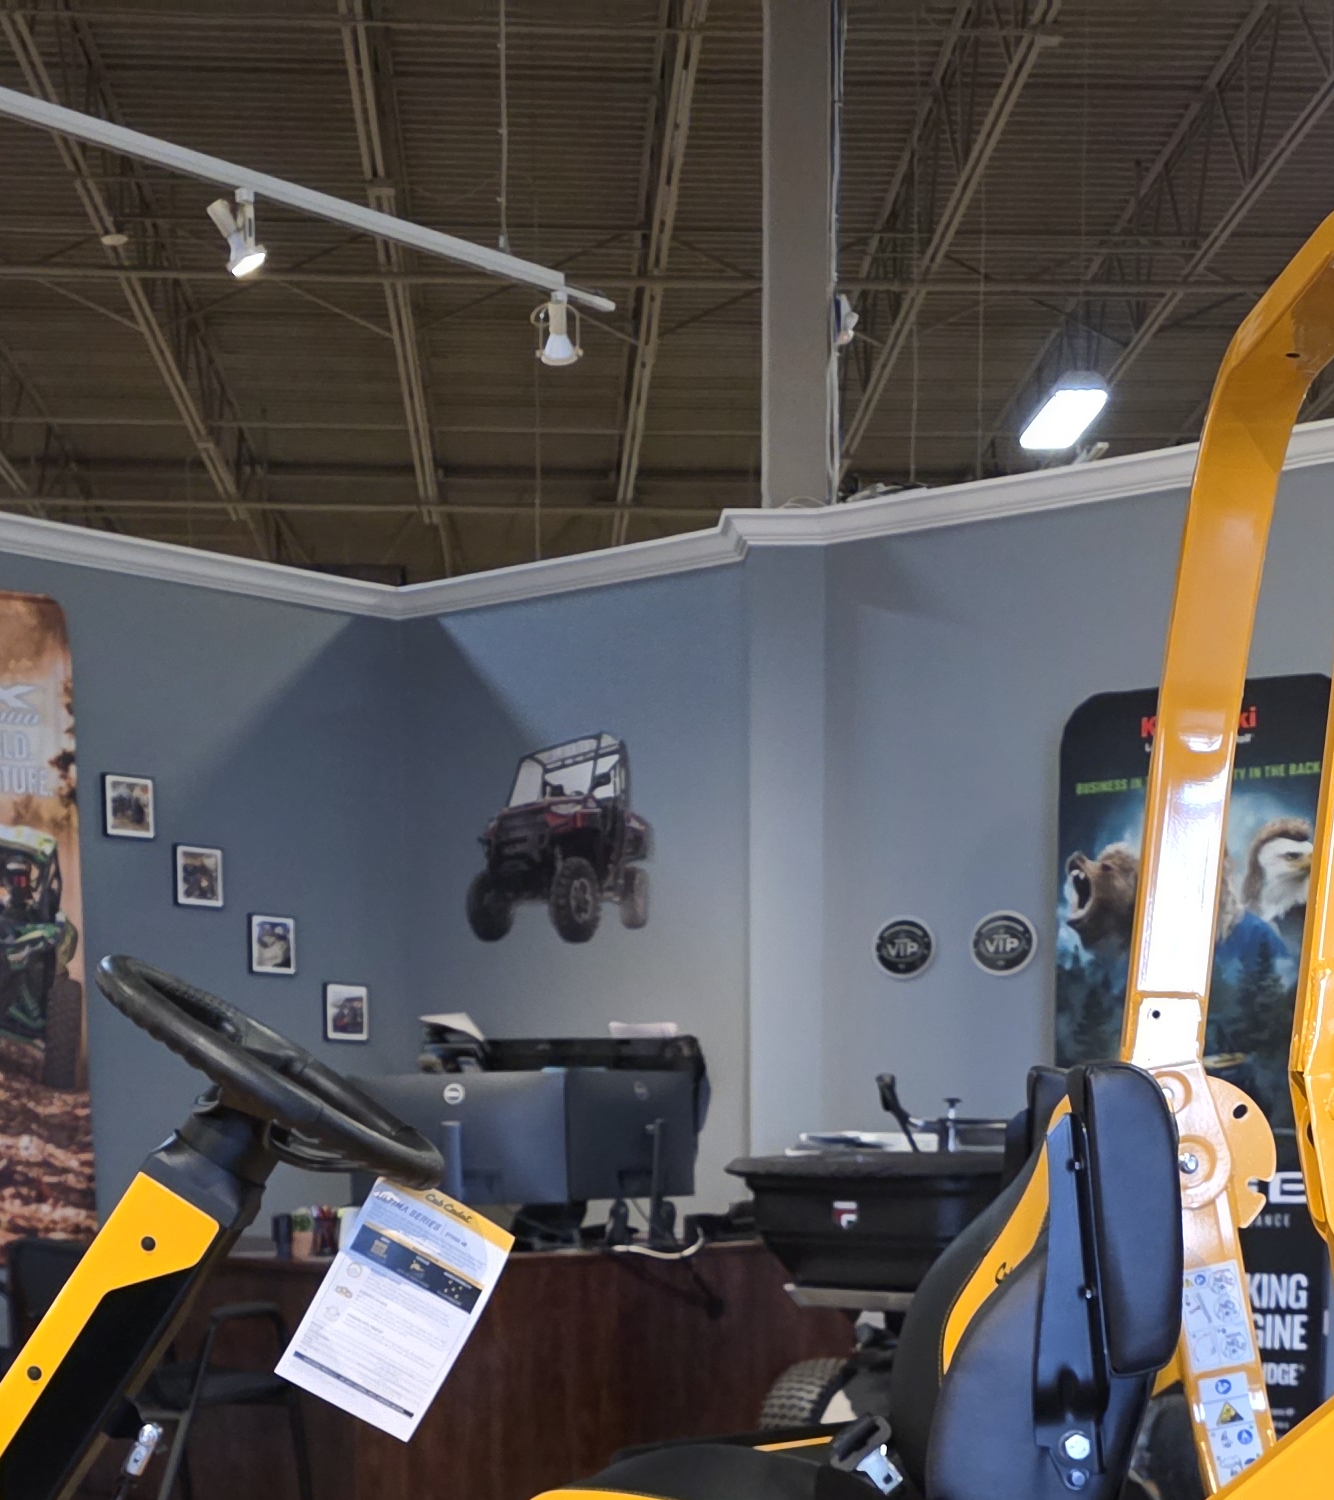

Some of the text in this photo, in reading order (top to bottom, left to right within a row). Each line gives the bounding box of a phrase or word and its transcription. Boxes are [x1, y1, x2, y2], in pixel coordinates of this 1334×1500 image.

[1248, 767, 1262, 779] IN
[1264, 763, 1286, 778] THE
[886, 940, 919, 958] VIP
[985, 935, 1020, 954] VIP
